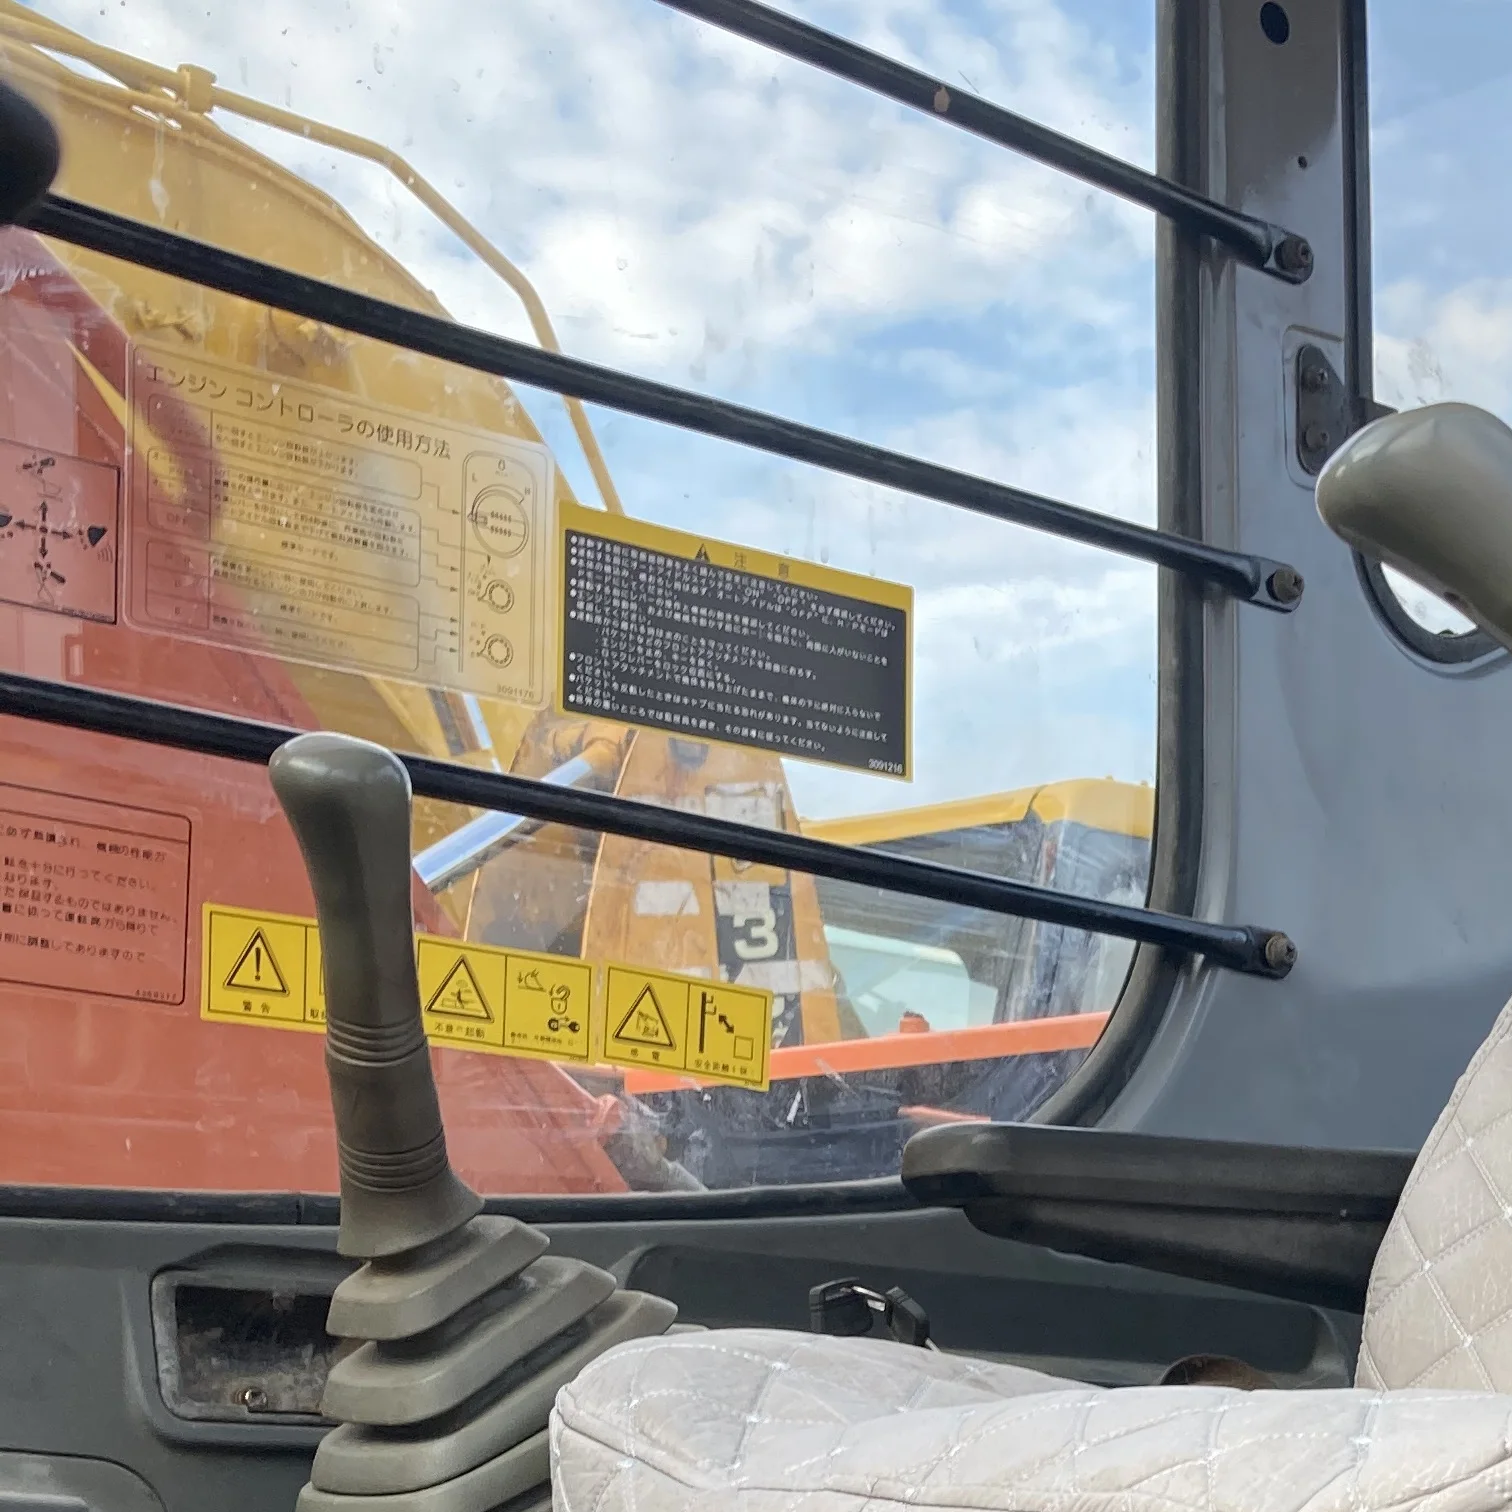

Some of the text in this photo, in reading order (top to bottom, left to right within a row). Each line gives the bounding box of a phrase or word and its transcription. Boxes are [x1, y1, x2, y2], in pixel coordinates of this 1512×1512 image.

[146, 364, 227, 399] エンジン
[236, 387, 452, 460] コントローラの使用方法
[732, 907, 779, 960] 3
